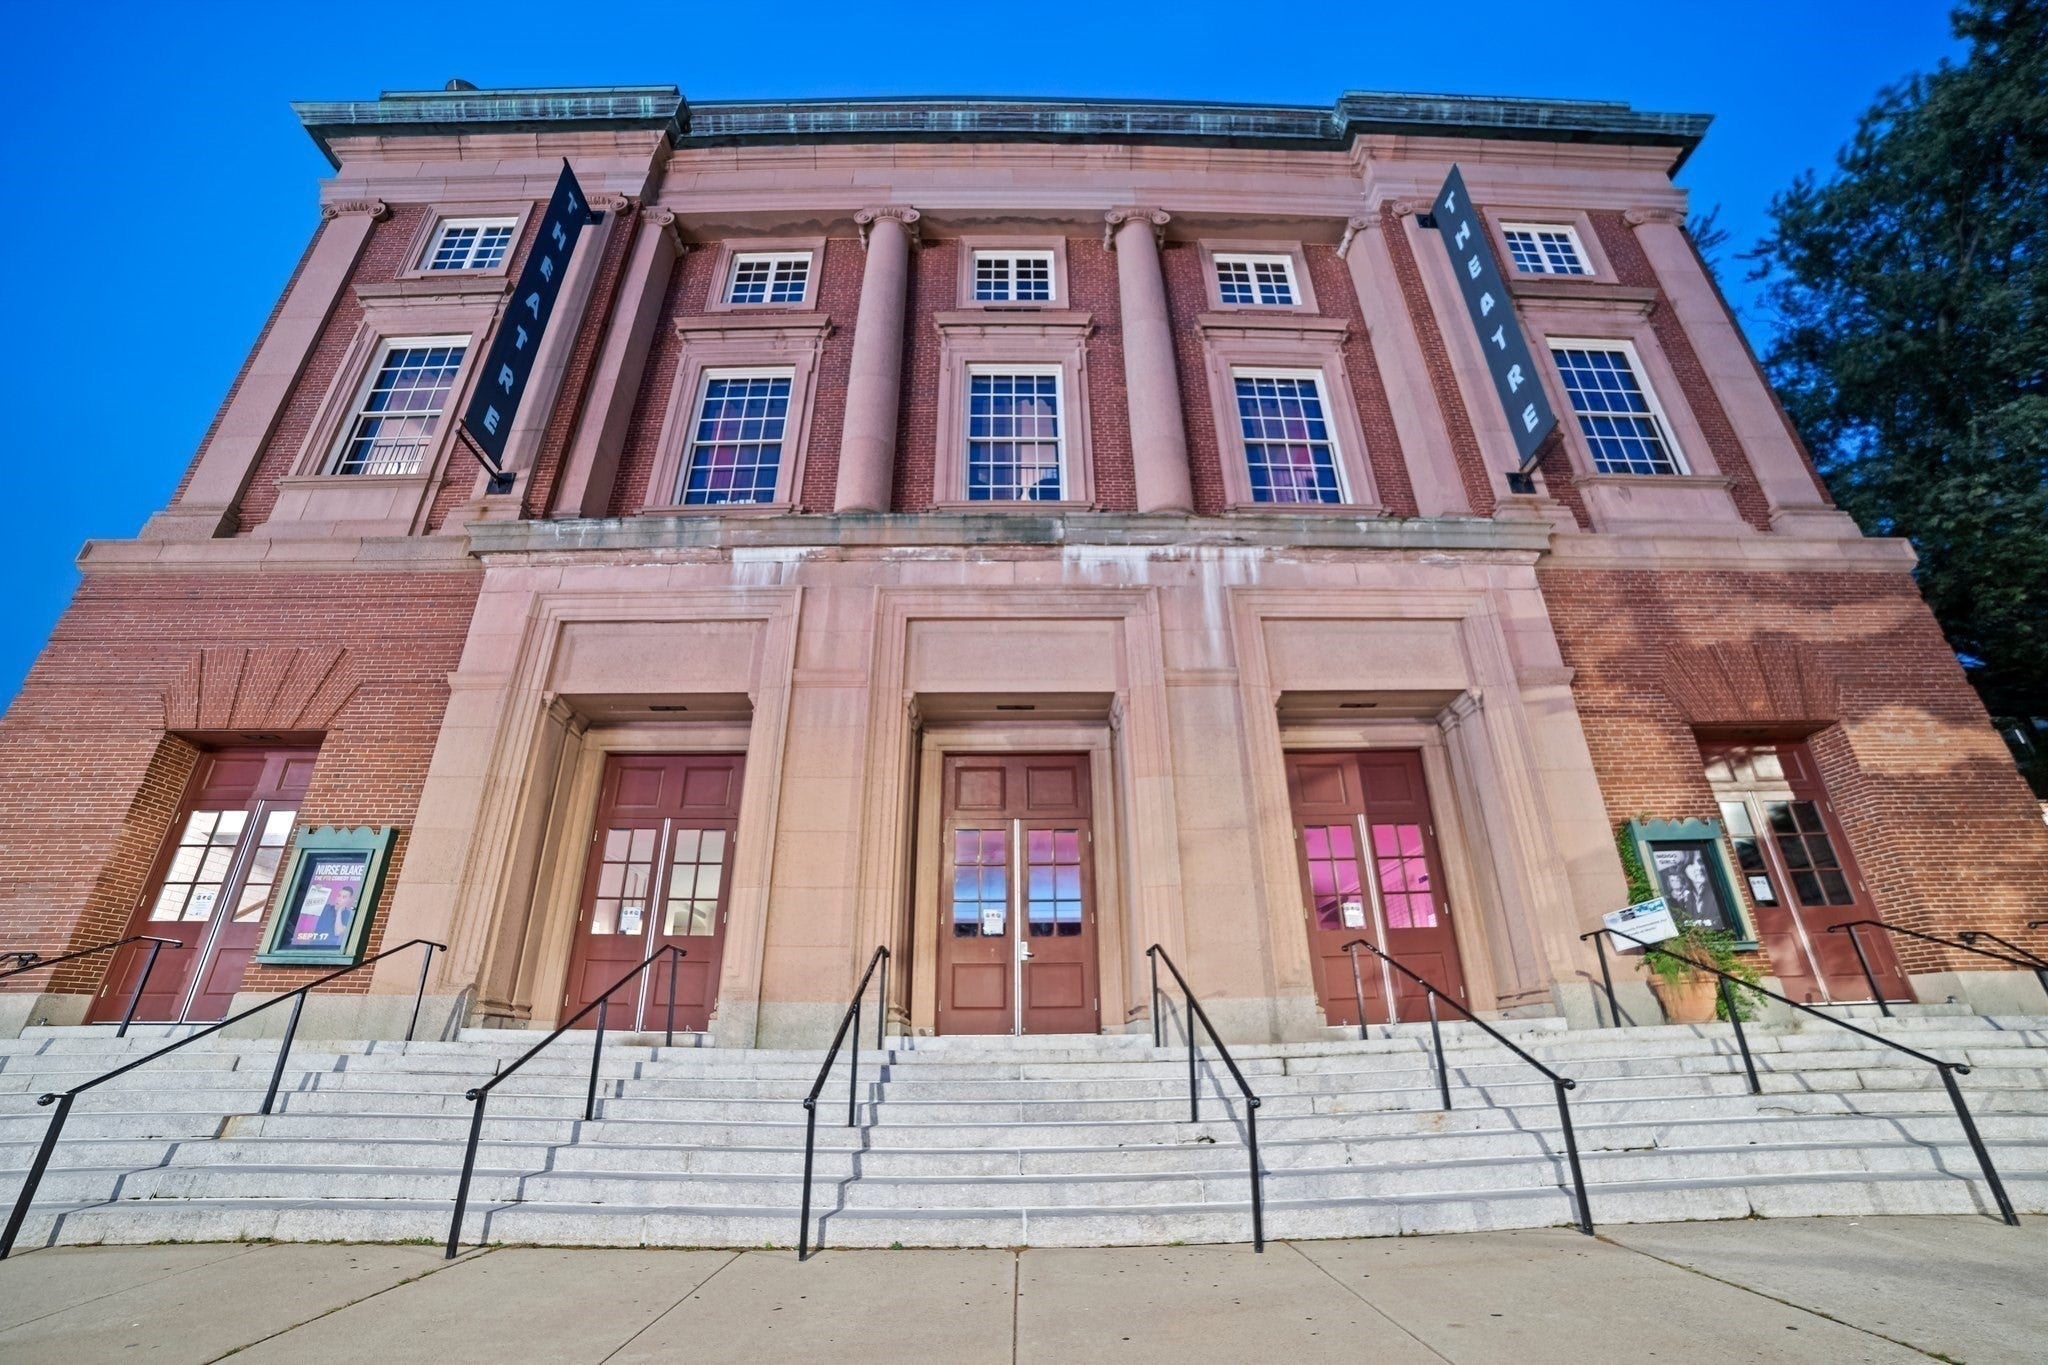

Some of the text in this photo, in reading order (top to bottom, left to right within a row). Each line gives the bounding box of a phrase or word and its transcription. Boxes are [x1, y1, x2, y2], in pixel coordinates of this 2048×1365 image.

[483, 191, 578, 436] THEATRE
[1444, 190, 1539, 434] THEATRE
[315, 865, 366, 875] NURSE BLAKE
